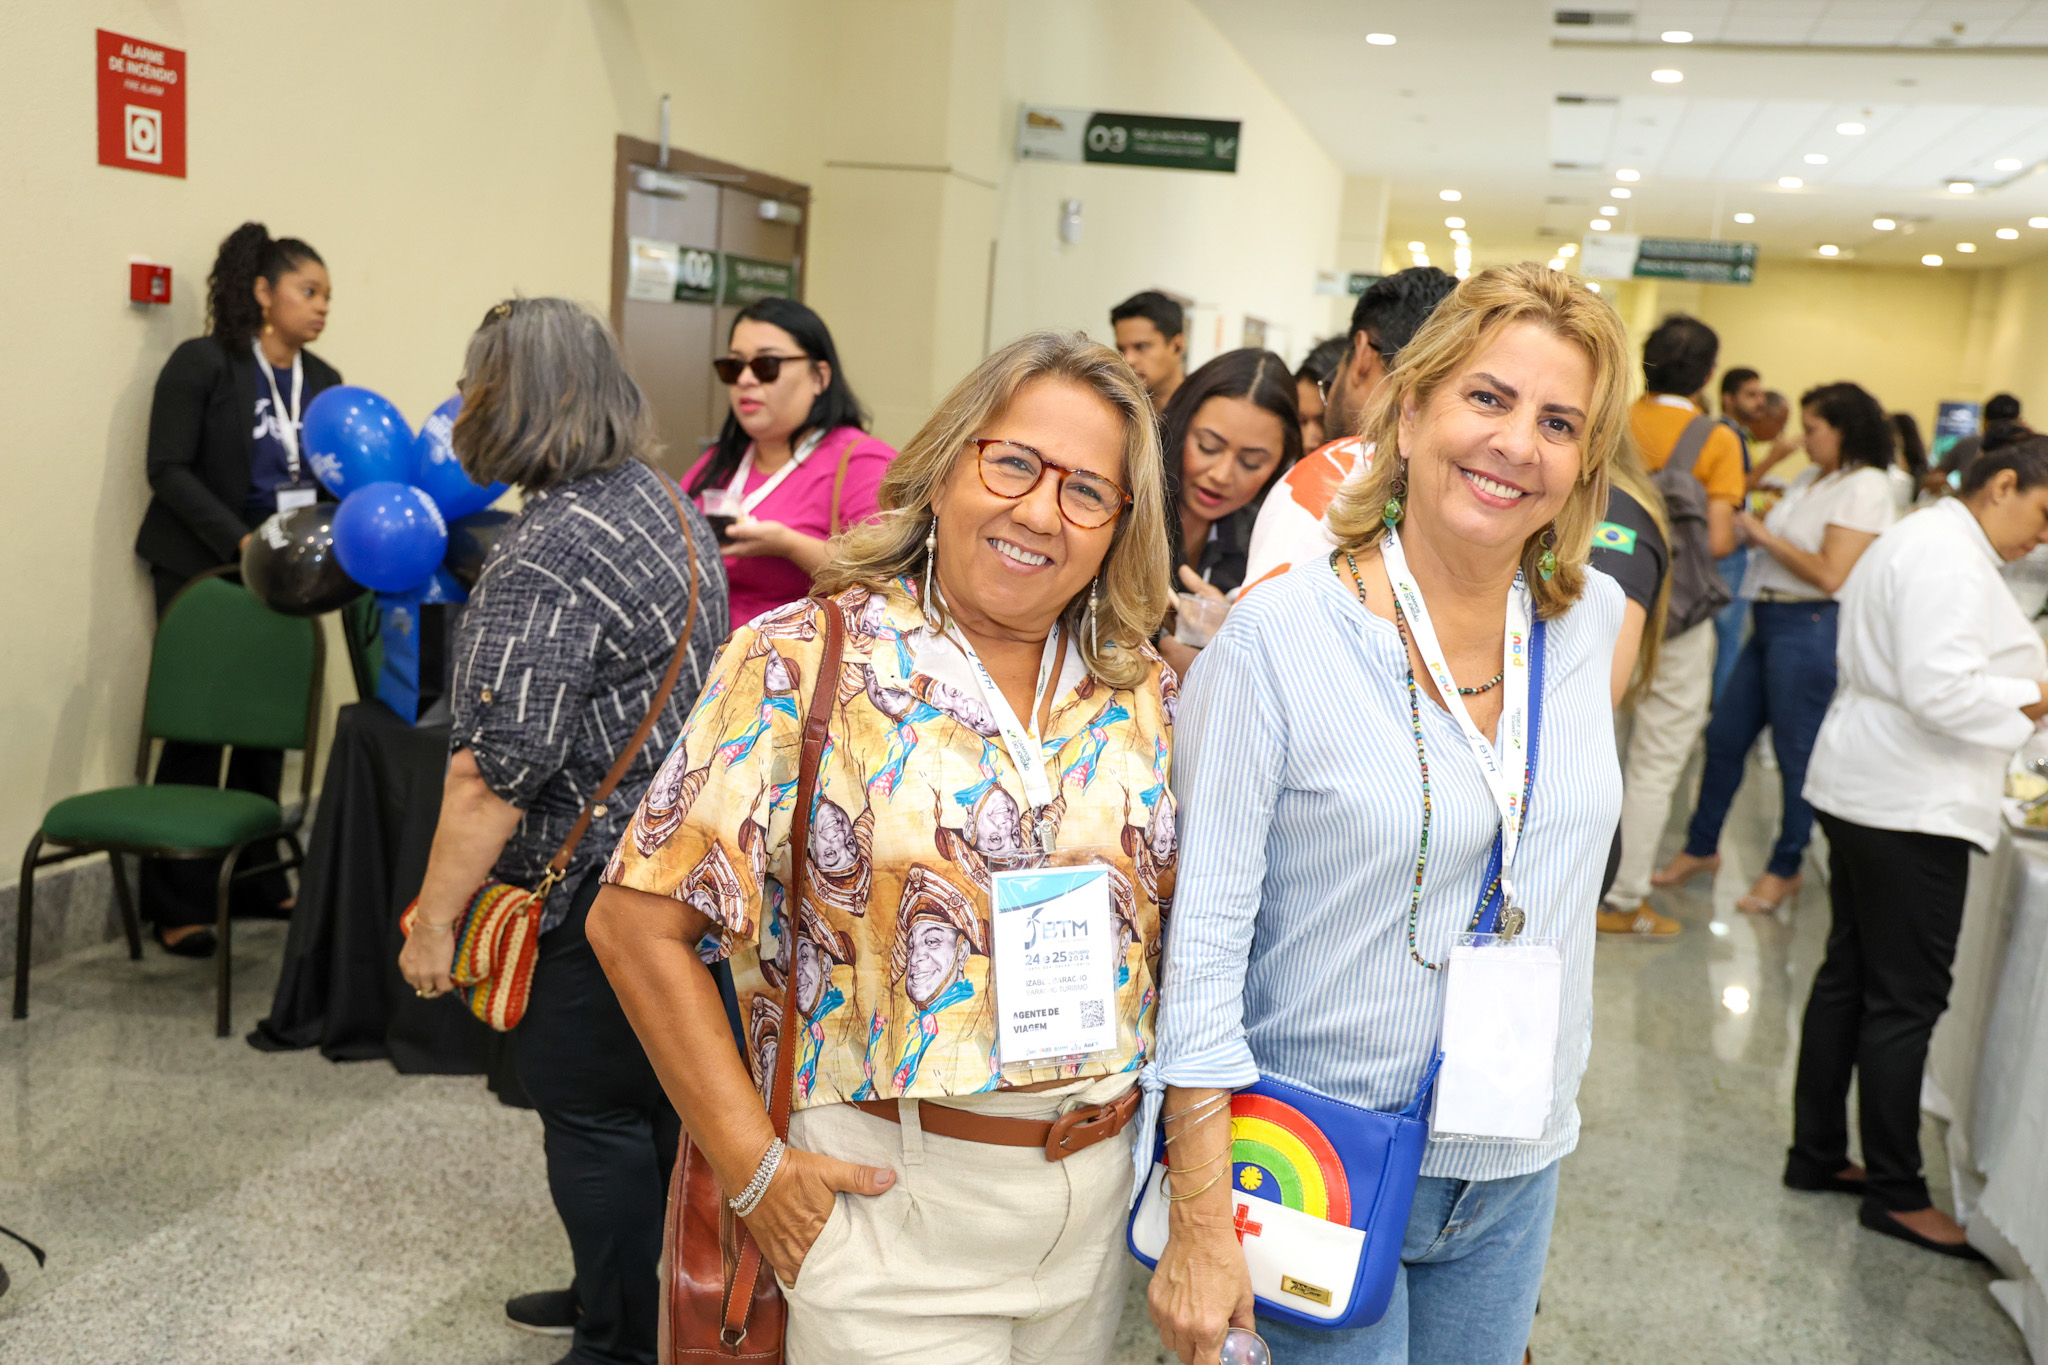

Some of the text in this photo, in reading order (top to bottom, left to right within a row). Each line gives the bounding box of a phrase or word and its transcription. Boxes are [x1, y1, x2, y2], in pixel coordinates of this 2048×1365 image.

[121, 42, 165, 65] ALARME
[108, 55, 124, 72] DE
[1088, 124, 1127, 153] 03
[684, 249, 713, 290] 02
[1403, 593, 1409, 601] DO
[1408, 591, 1421, 614] CAMPOS
[1011, 740, 1019, 750] DO
[1016, 738, 1031, 761] CAMPOS
[1478, 743, 1496, 772] BTM
[1025, 953, 1040, 966] 24
[1052, 951, 1067, 963] 25
[1069, 954, 1090, 962] 2024
[1059, 983, 1088, 993] TURISMO
[1013, 1007, 1060, 1020] AGENTE DE
[1013, 1022, 1047, 1034] VIAGEM
